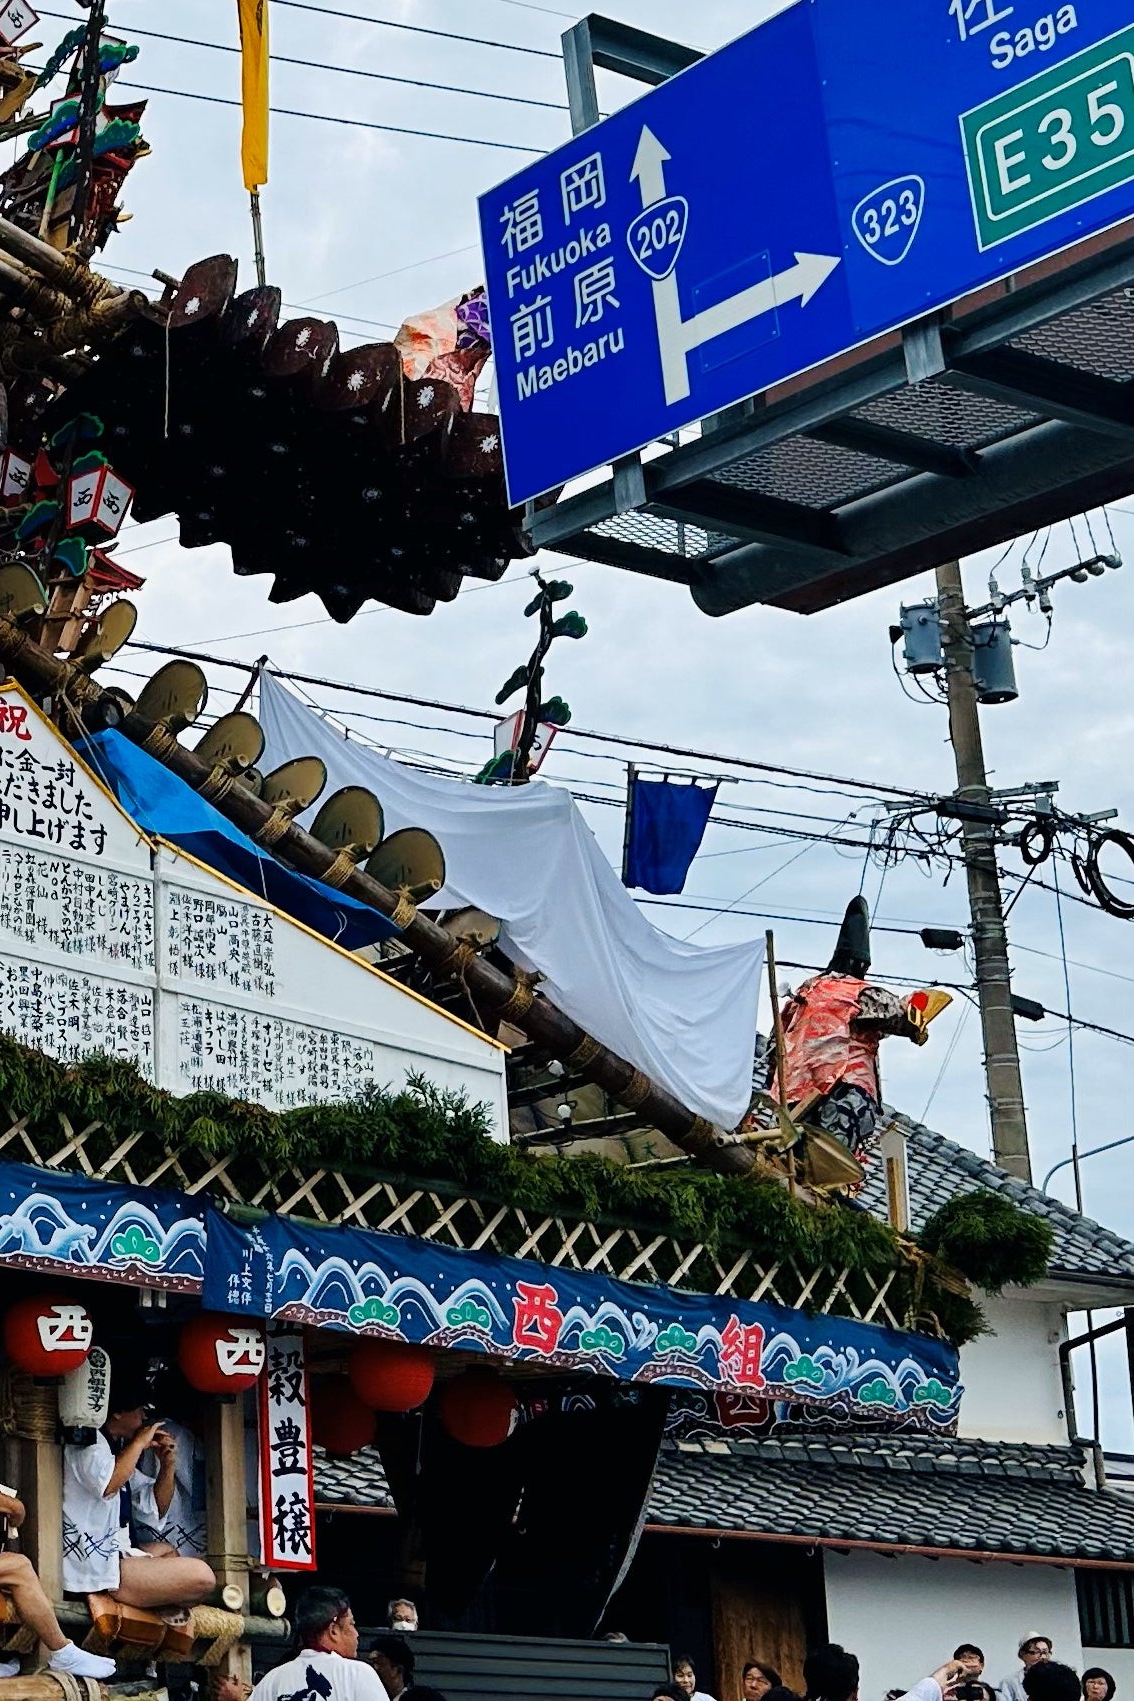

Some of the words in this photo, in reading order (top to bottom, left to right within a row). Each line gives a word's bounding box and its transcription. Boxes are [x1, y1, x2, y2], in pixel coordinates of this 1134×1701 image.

[989, 4, 1078, 69] Saga
[993, 80, 1125, 196] E35
[499, 151, 607, 258] 福岡
[637, 209, 681, 261] 202
[863, 189, 917, 244] 323
[506, 222, 612, 299] Fukuoka
[509, 255, 620, 363] 前原
[516, 327, 625, 402] Maebaru
[37, 1305, 93, 1352] 西
[215, 1328, 266, 1376] 西
[513, 1280, 563, 1356] 西
[719, 1314, 767, 1389] 組
